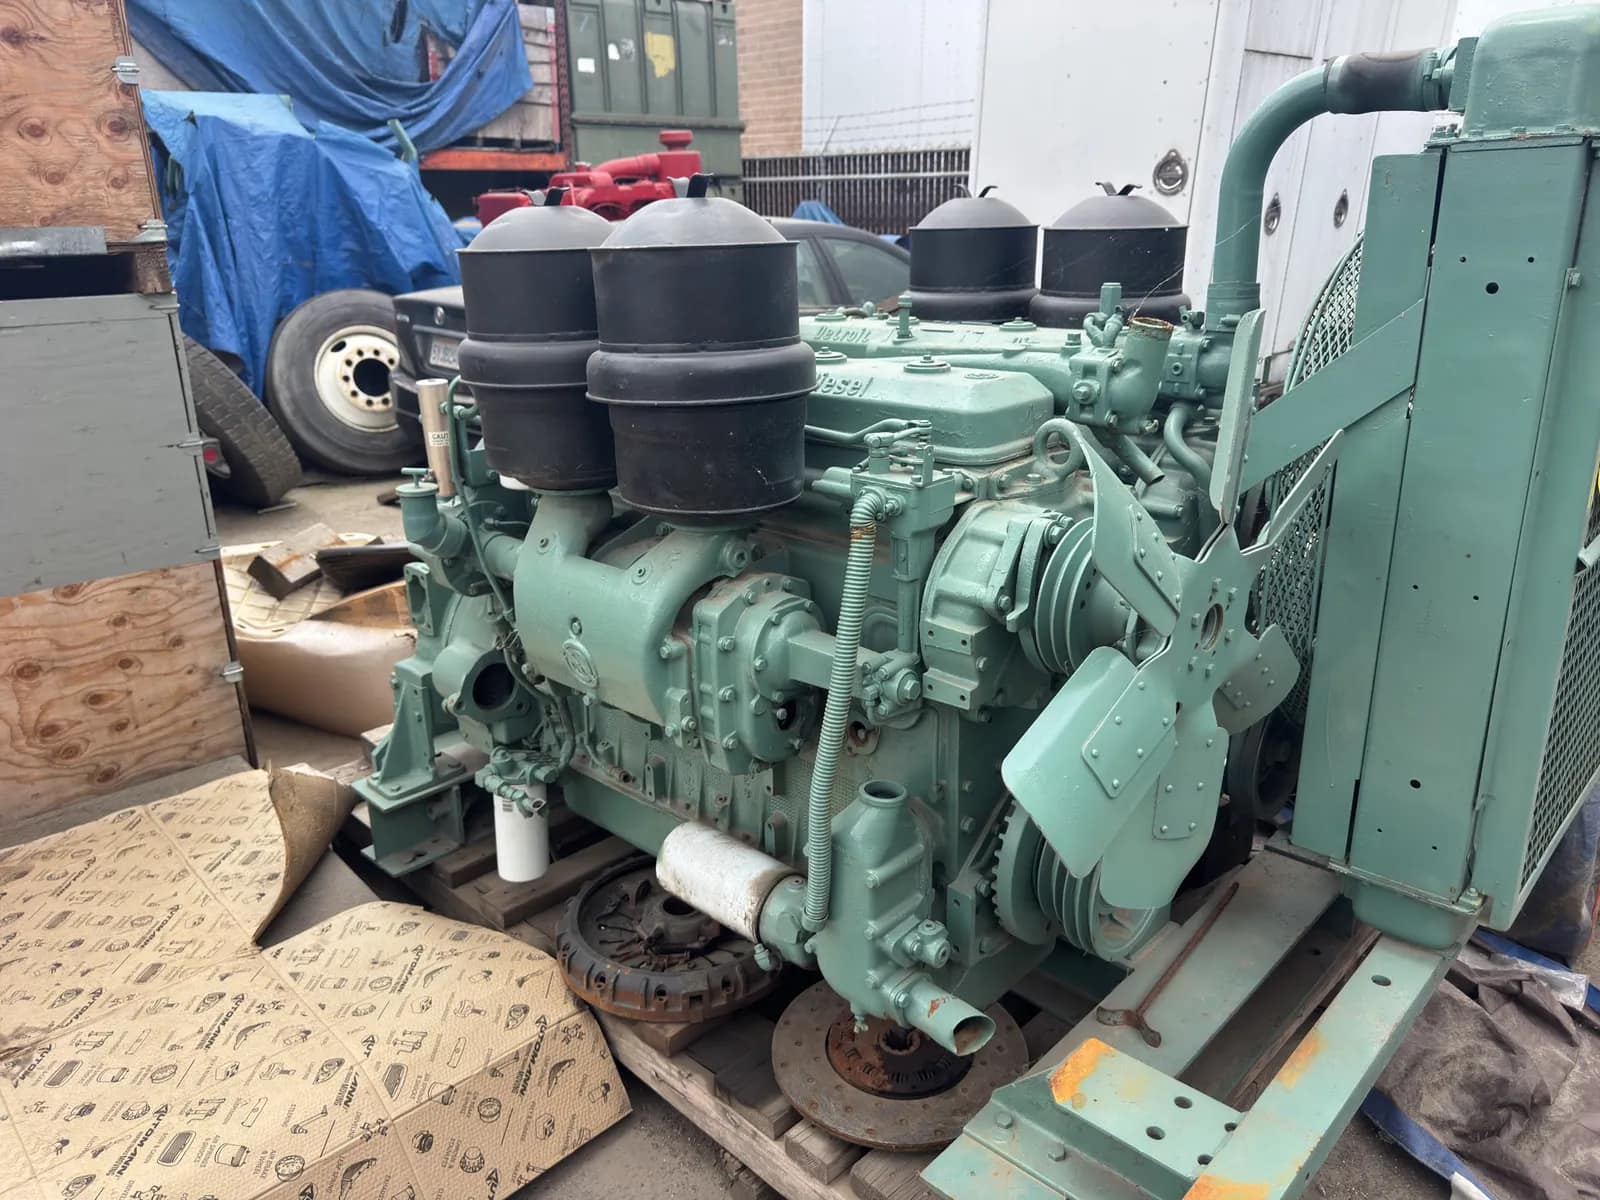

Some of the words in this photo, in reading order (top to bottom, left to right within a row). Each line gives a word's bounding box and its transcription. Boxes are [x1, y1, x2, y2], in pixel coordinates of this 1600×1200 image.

[814, 325, 872, 343] Detroit
[204, 993, 244, 1049] AUTOMANN
[519, 1015, 546, 1096] AUTOMANN
[116, 1104, 167, 1176] AUTOMANN
